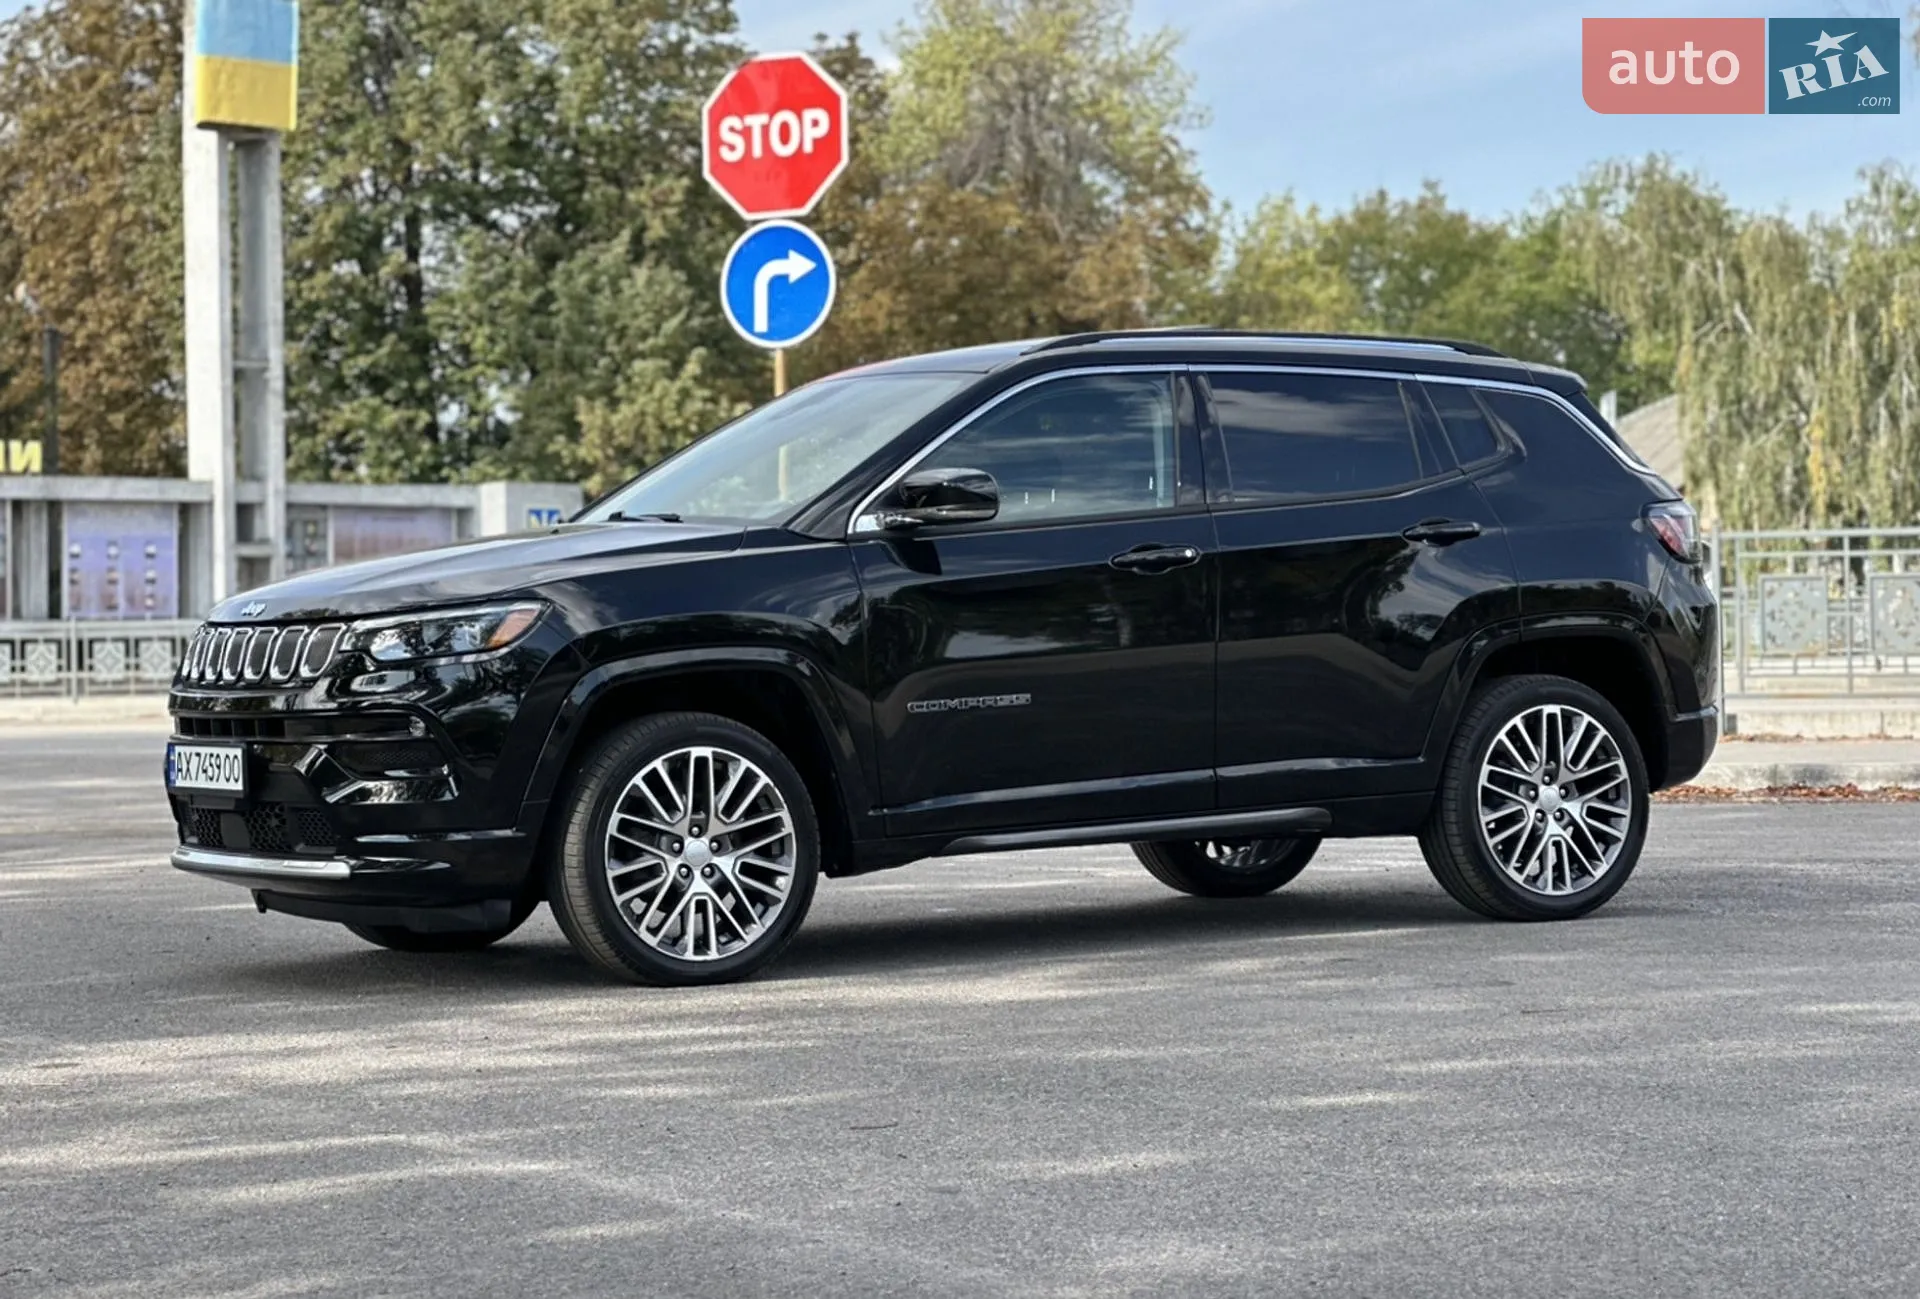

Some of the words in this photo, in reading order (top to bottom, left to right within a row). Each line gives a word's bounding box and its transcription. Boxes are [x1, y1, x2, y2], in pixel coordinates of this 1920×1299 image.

[718, 107, 831, 163] STOP
[0, 438, 43, 473] И
[906, 693, 1032, 713] COMPASS
[176, 751, 193, 782] AX
[194, 752, 222, 783] 7459
